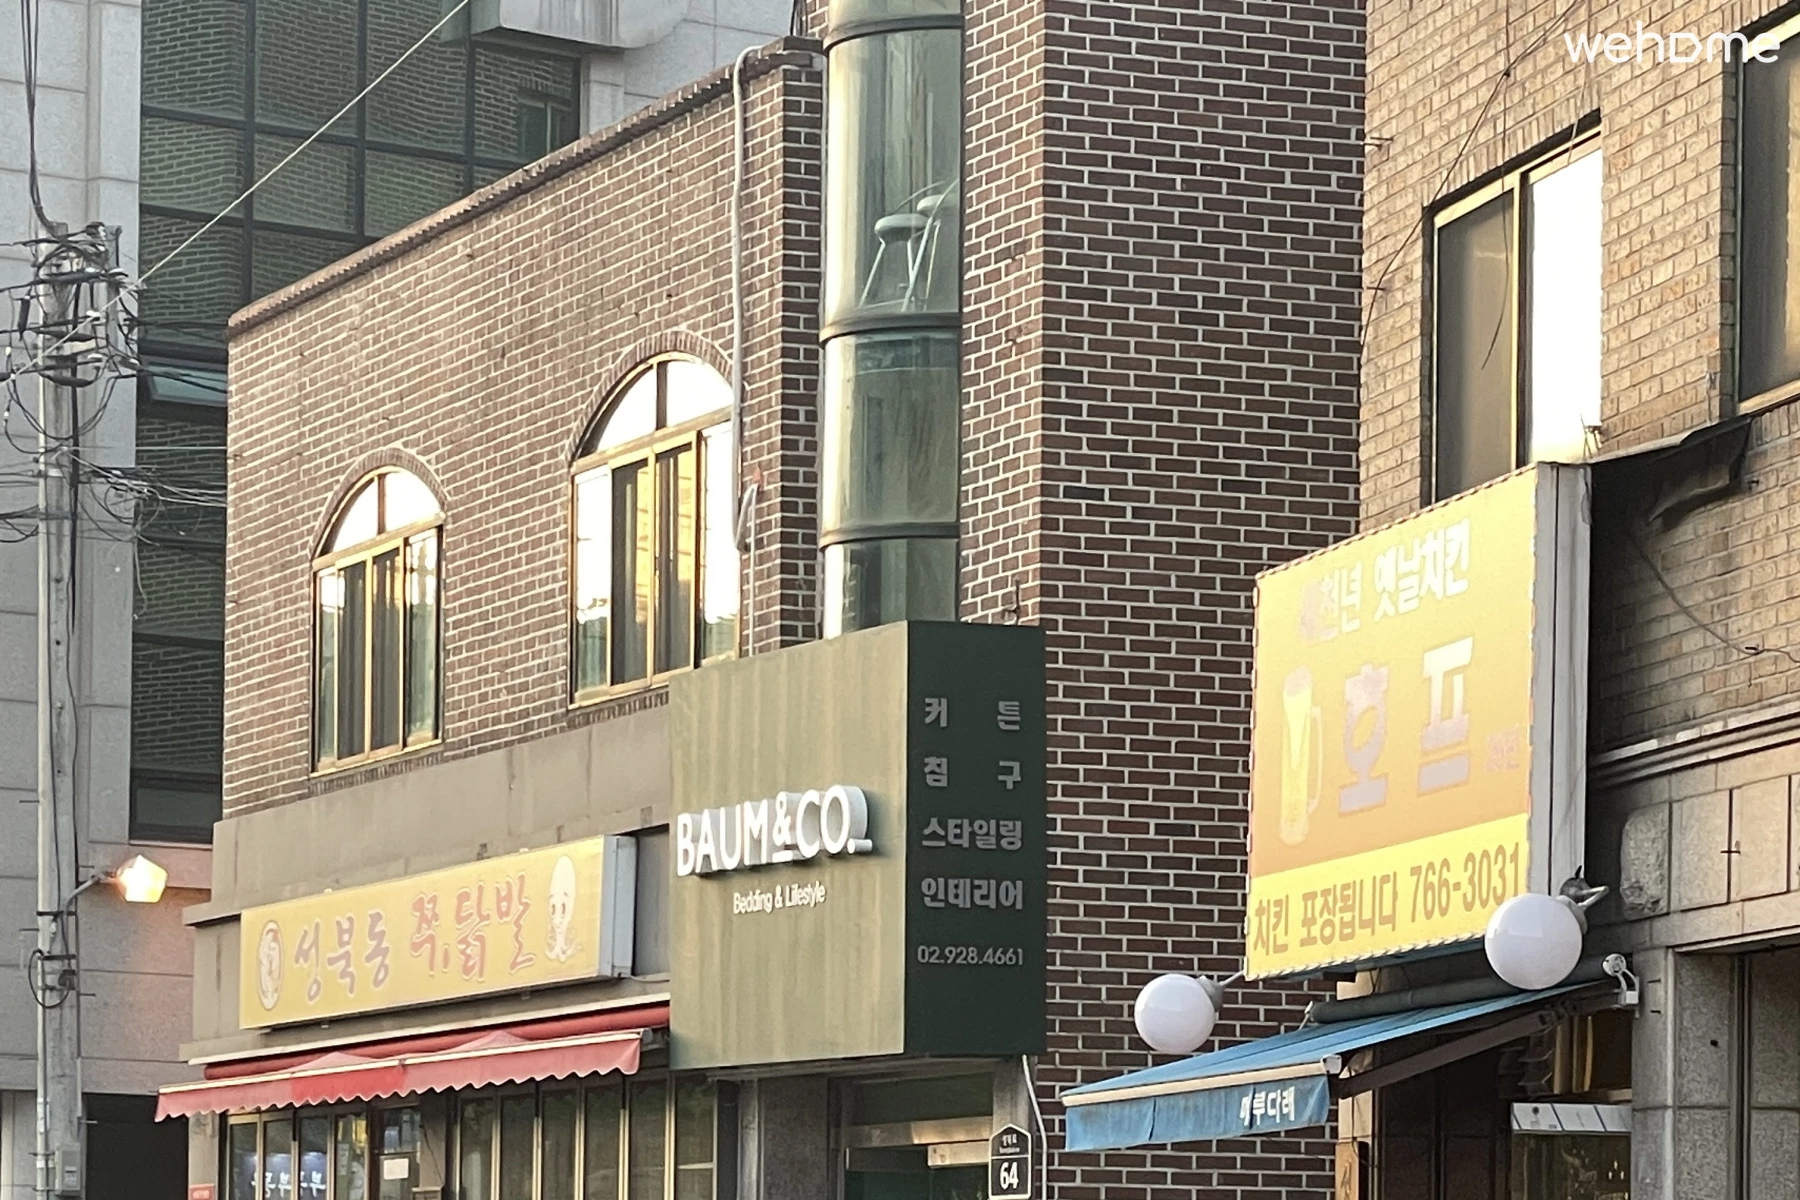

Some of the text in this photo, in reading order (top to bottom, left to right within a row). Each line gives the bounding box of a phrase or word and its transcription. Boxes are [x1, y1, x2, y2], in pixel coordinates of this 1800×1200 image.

[1373, 518, 1470, 623] 옛날치킨
[921, 817, 1023, 851] 스타일링
[733, 889, 773, 914] Bedding
[921, 877, 1023, 910] 인테리어
[1253, 841, 1521, 956] 치킨 포장됩니다 766-3031
[294, 911, 390, 1003] 성북동
[917, 945, 1024, 966] 02.928.4661
[1000, 1161, 1019, 1190] 64
